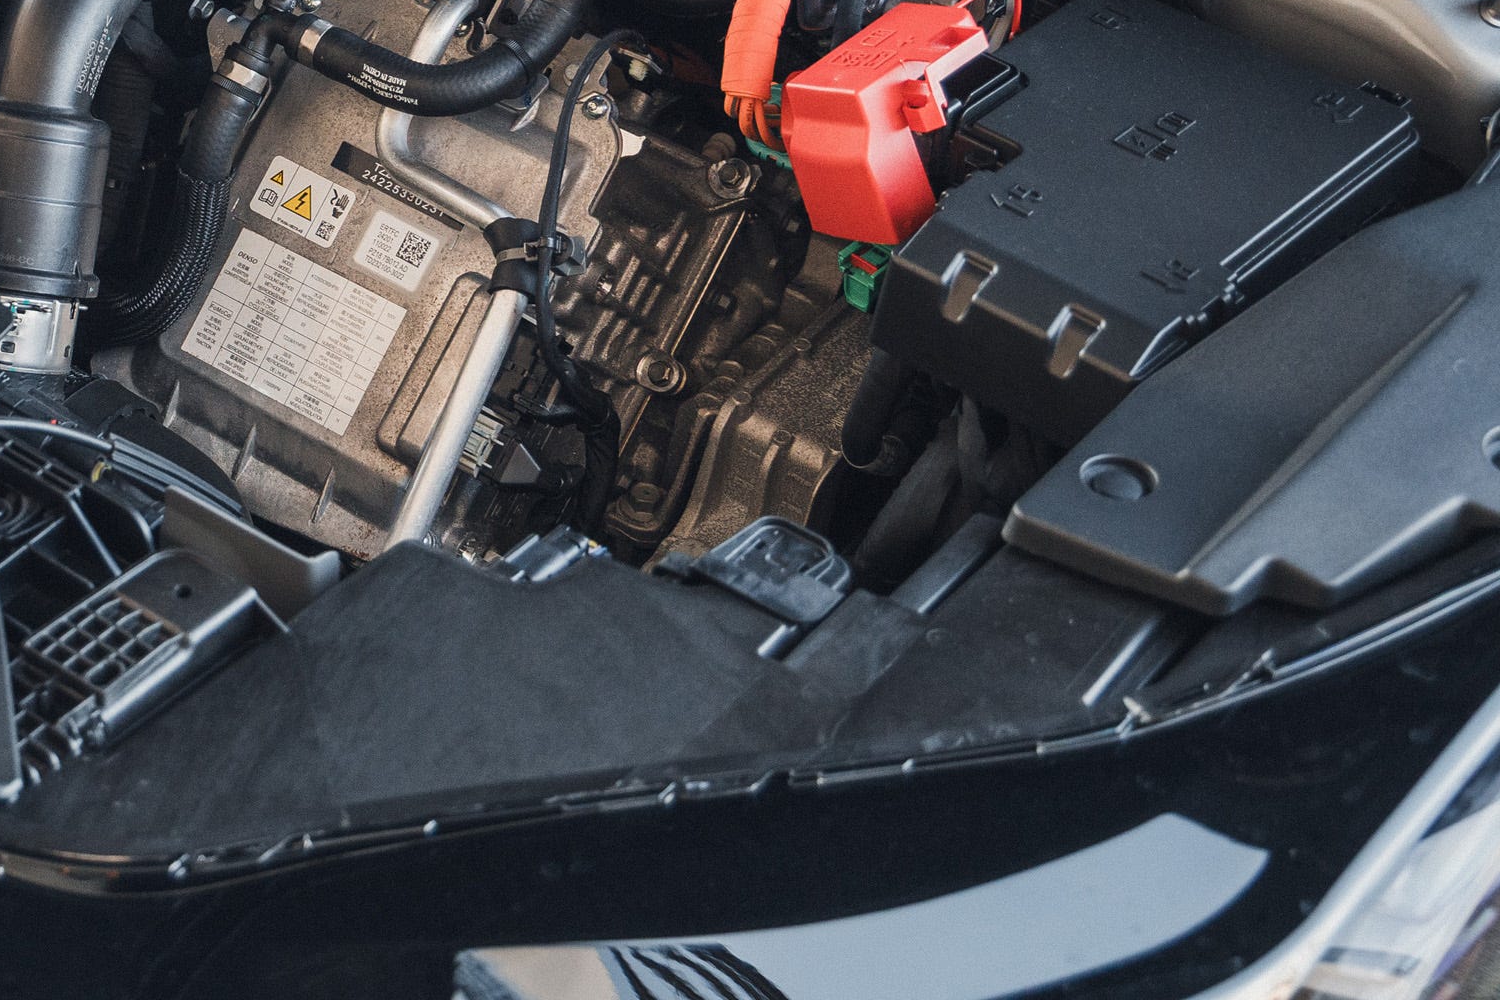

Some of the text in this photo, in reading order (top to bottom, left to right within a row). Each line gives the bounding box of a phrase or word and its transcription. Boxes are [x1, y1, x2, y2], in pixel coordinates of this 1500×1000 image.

[363, 63, 407, 86] MADE IN CHINA
[237, 250, 258, 264] DENSO
[209, 303, 231, 318] FoMoCo
